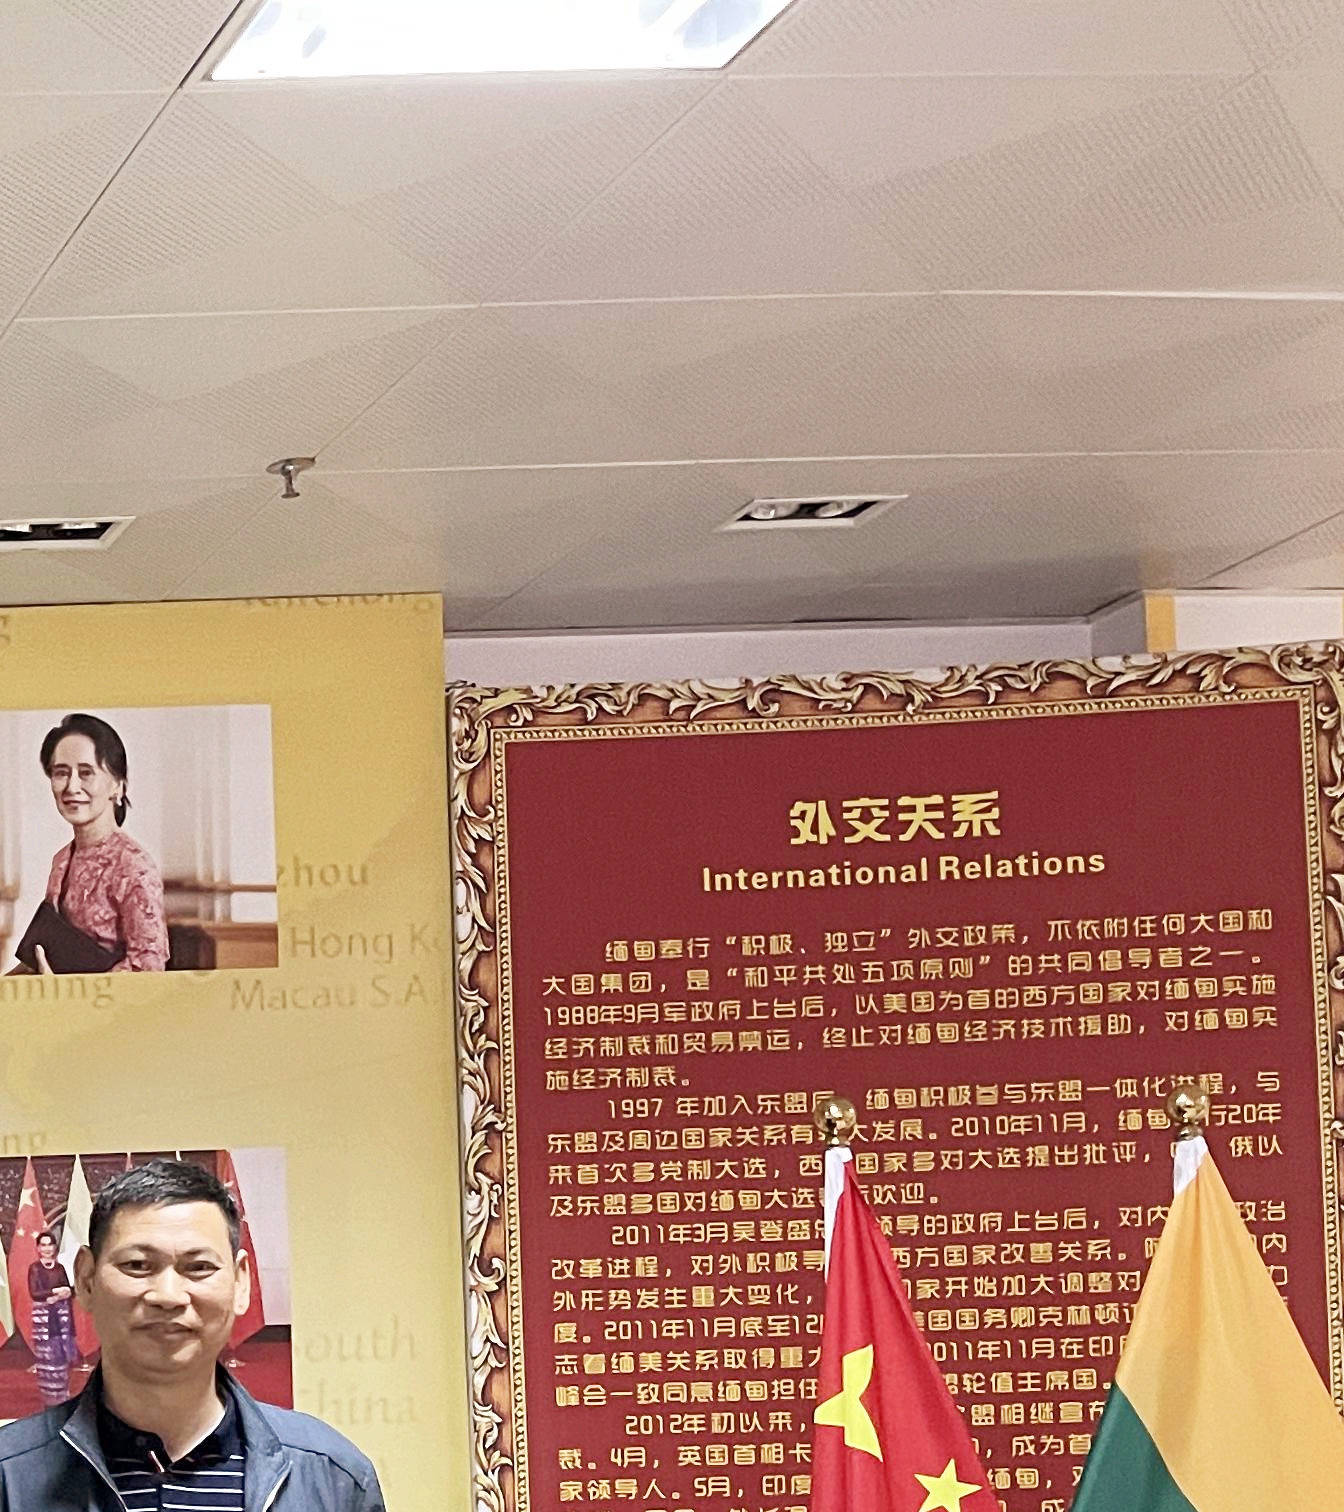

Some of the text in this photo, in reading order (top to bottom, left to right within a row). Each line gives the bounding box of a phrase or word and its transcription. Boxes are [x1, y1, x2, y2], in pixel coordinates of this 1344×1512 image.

[789, 790, 1001, 845] 外交关系
[702, 851, 1106, 892] International Relations
[289, 925, 395, 964] Hong
[230, 977, 356, 1011] Macau
[607, 1097, 663, 1119] 1997
